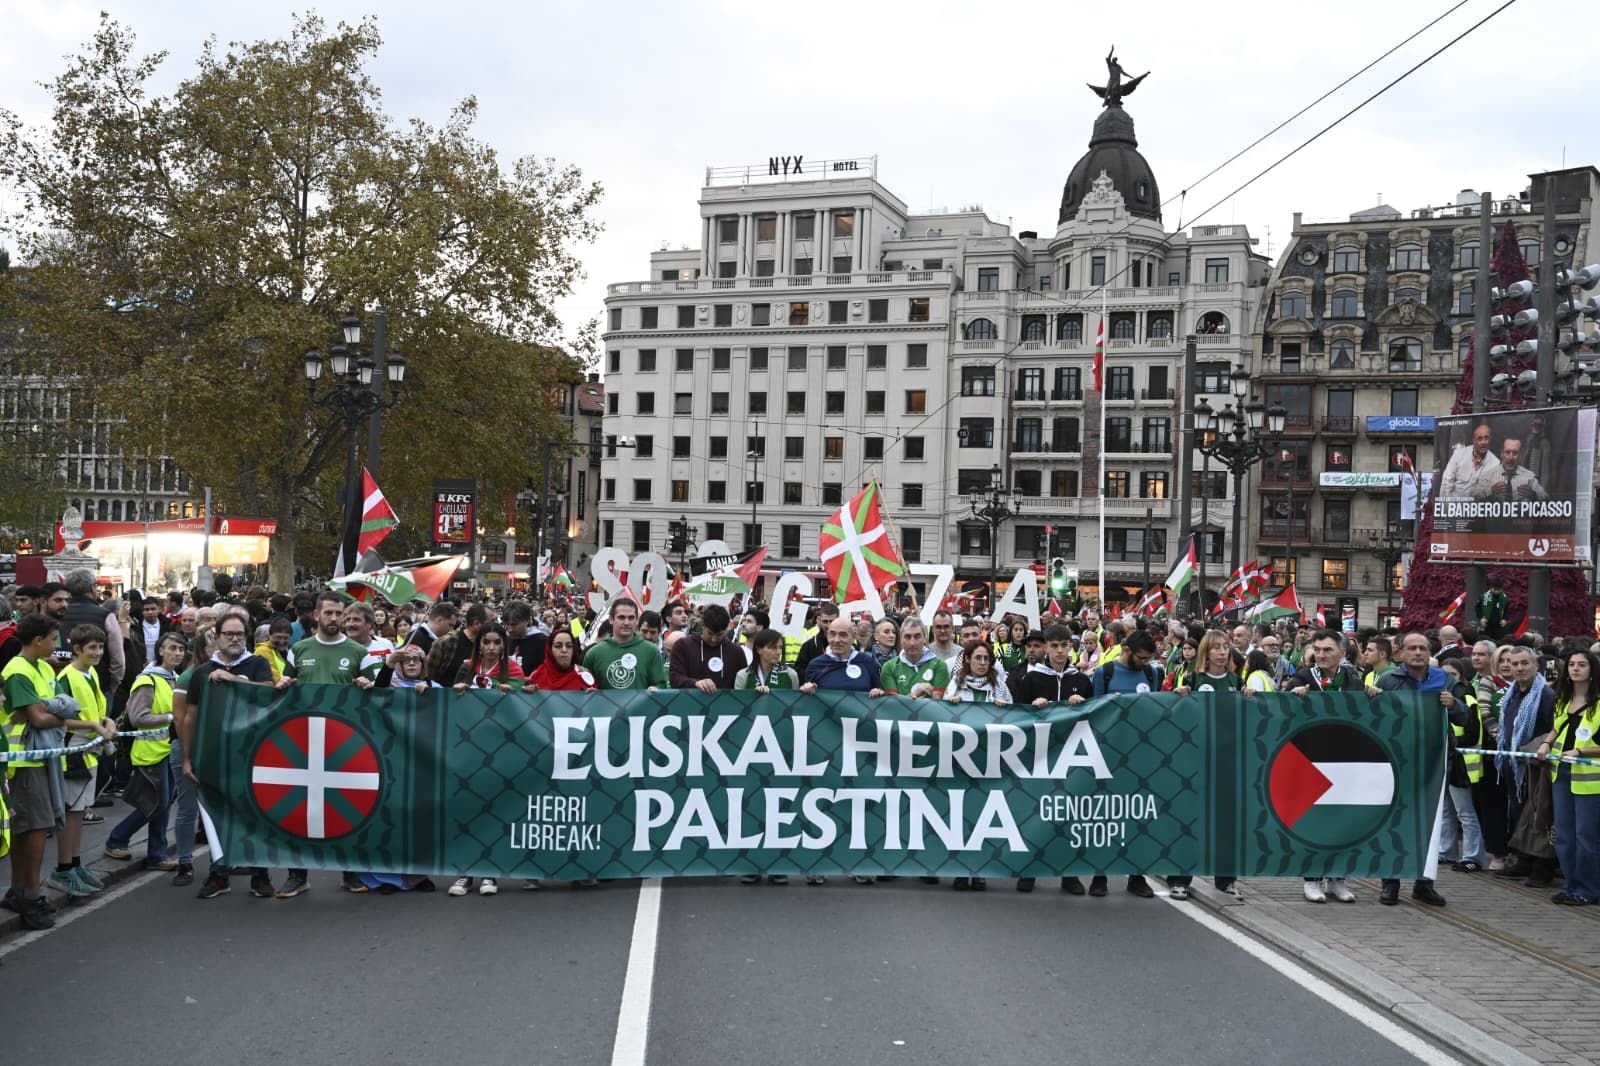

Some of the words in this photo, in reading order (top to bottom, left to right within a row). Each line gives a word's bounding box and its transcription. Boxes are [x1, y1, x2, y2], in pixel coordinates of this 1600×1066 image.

[769, 155, 803, 175] NYX
[833, 161, 858, 171] HOTEL
[1388, 418, 1421, 430] global
[439, 504, 467, 514] CHOLLAZO
[447, 494, 472, 503] KFC
[1434, 502, 1447, 518] EL
[1448, 501, 1501, 518] BARBERO
[1502, 501, 1518, 518] DE
[1521, 500, 1572, 518] PICASSO
[551, 714, 830, 780] EUSKAL
[841, 716, 1114, 779] HERRIA
[527, 795, 587, 823] HERRI
[632, 787, 1029, 852] PALESTINA
[1039, 793, 1158, 822] GENOZIDIOA
[510, 823, 602, 851] LIBREAK!
[1070, 821, 1126, 849] STOP!
